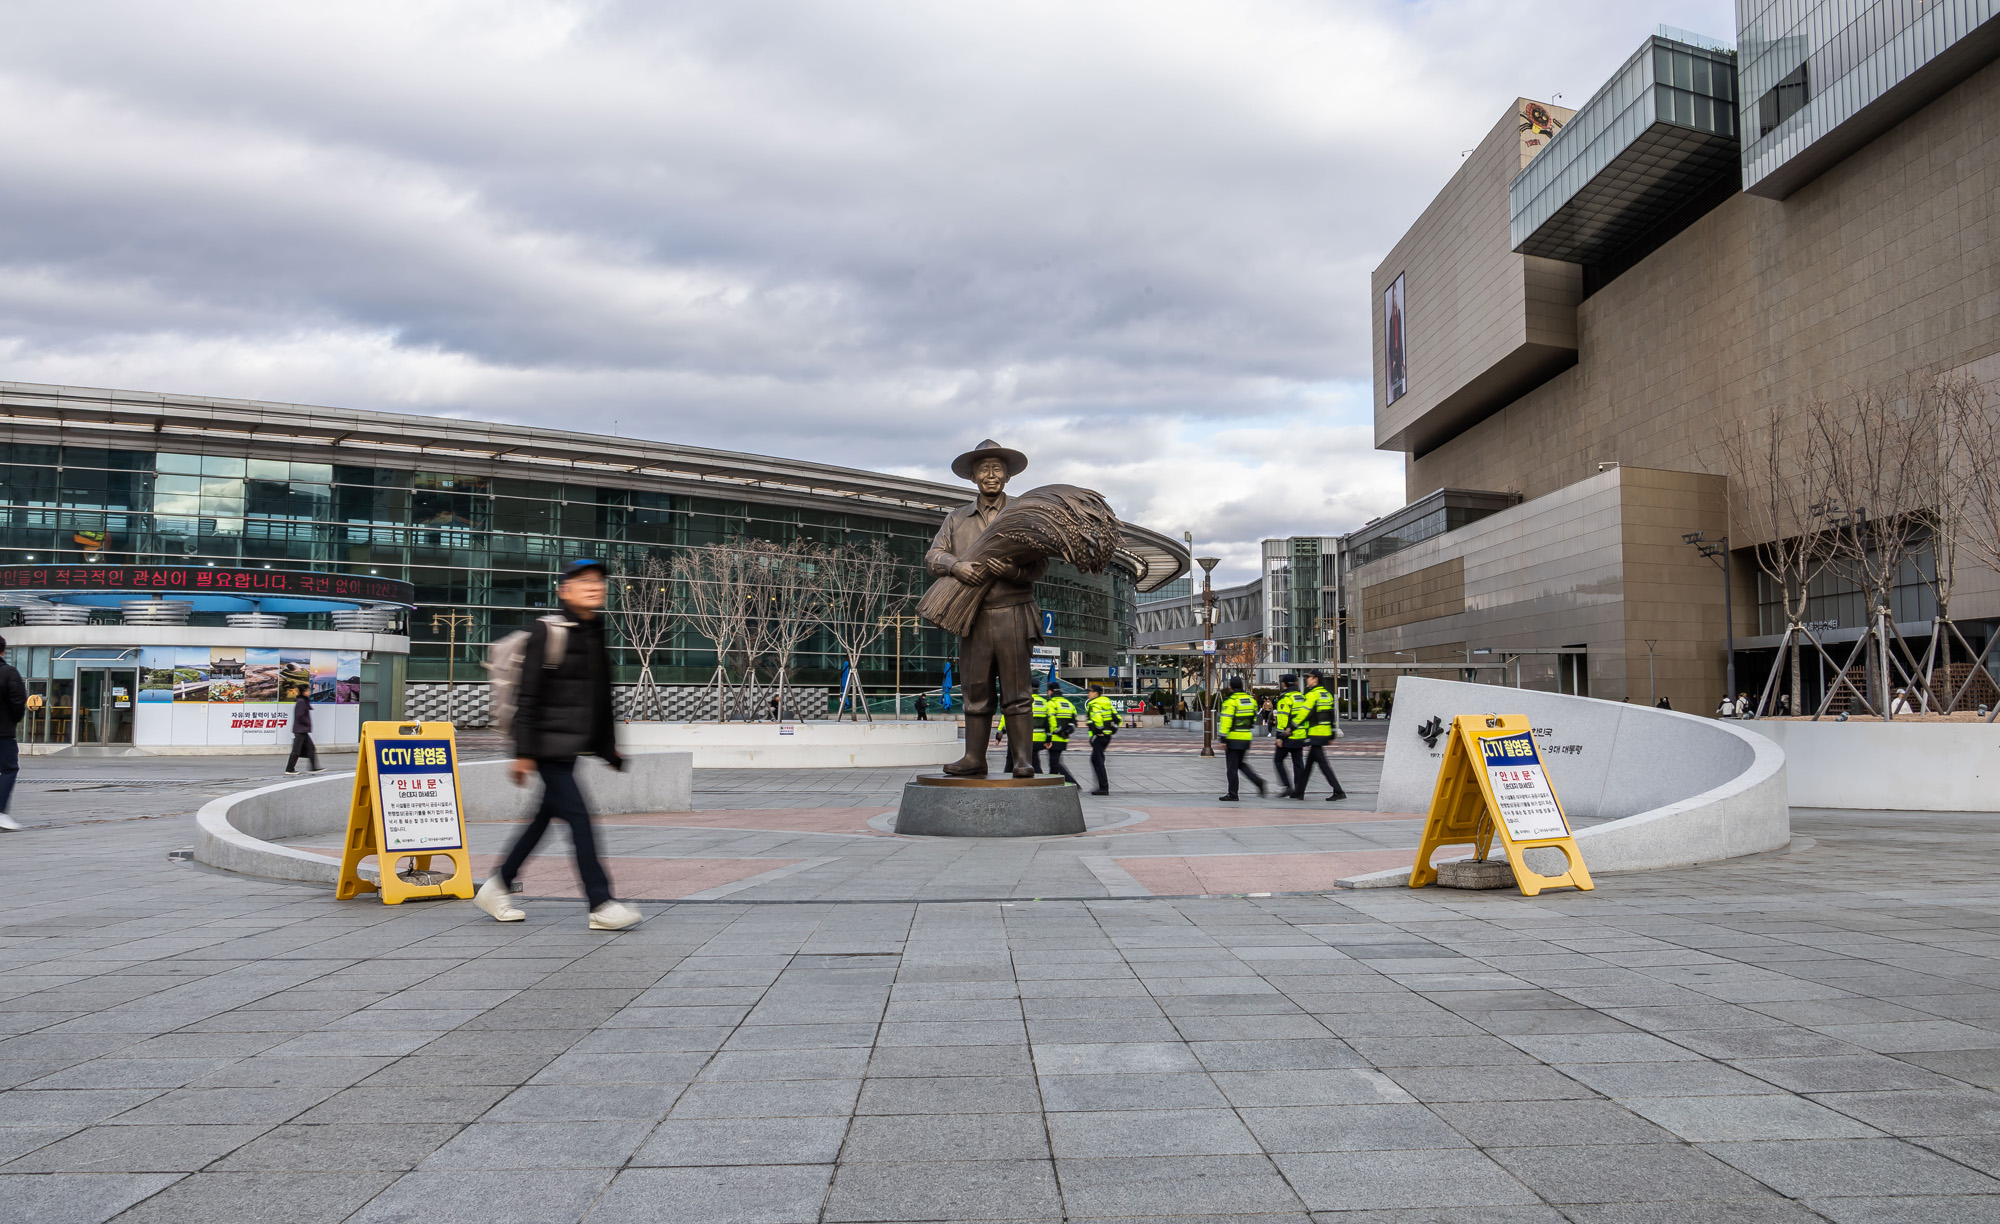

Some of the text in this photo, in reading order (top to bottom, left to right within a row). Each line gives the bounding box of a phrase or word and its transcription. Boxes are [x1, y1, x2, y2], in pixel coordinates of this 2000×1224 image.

[0, 570, 48, 586] 민들의
[56, 570, 124, 586] 적극적인
[132, 570, 186, 586] 관심이
[196, 571, 292, 590] 필요합니다.
[300, 576, 329, 593] 국번
[336, 578, 360, 594] 없이
[1046, 613, 1052, 634] 2
[1111, 668, 1116, 676] 2
[231, 719, 288, 728] 파워풀 대구
[381, 748, 447, 766] CCTV 촬영중
[1504, 739, 1533, 757] 촬영중
[1548, 745, 1560, 754] 9대
[1562, 745, 1582, 754] 대통령
